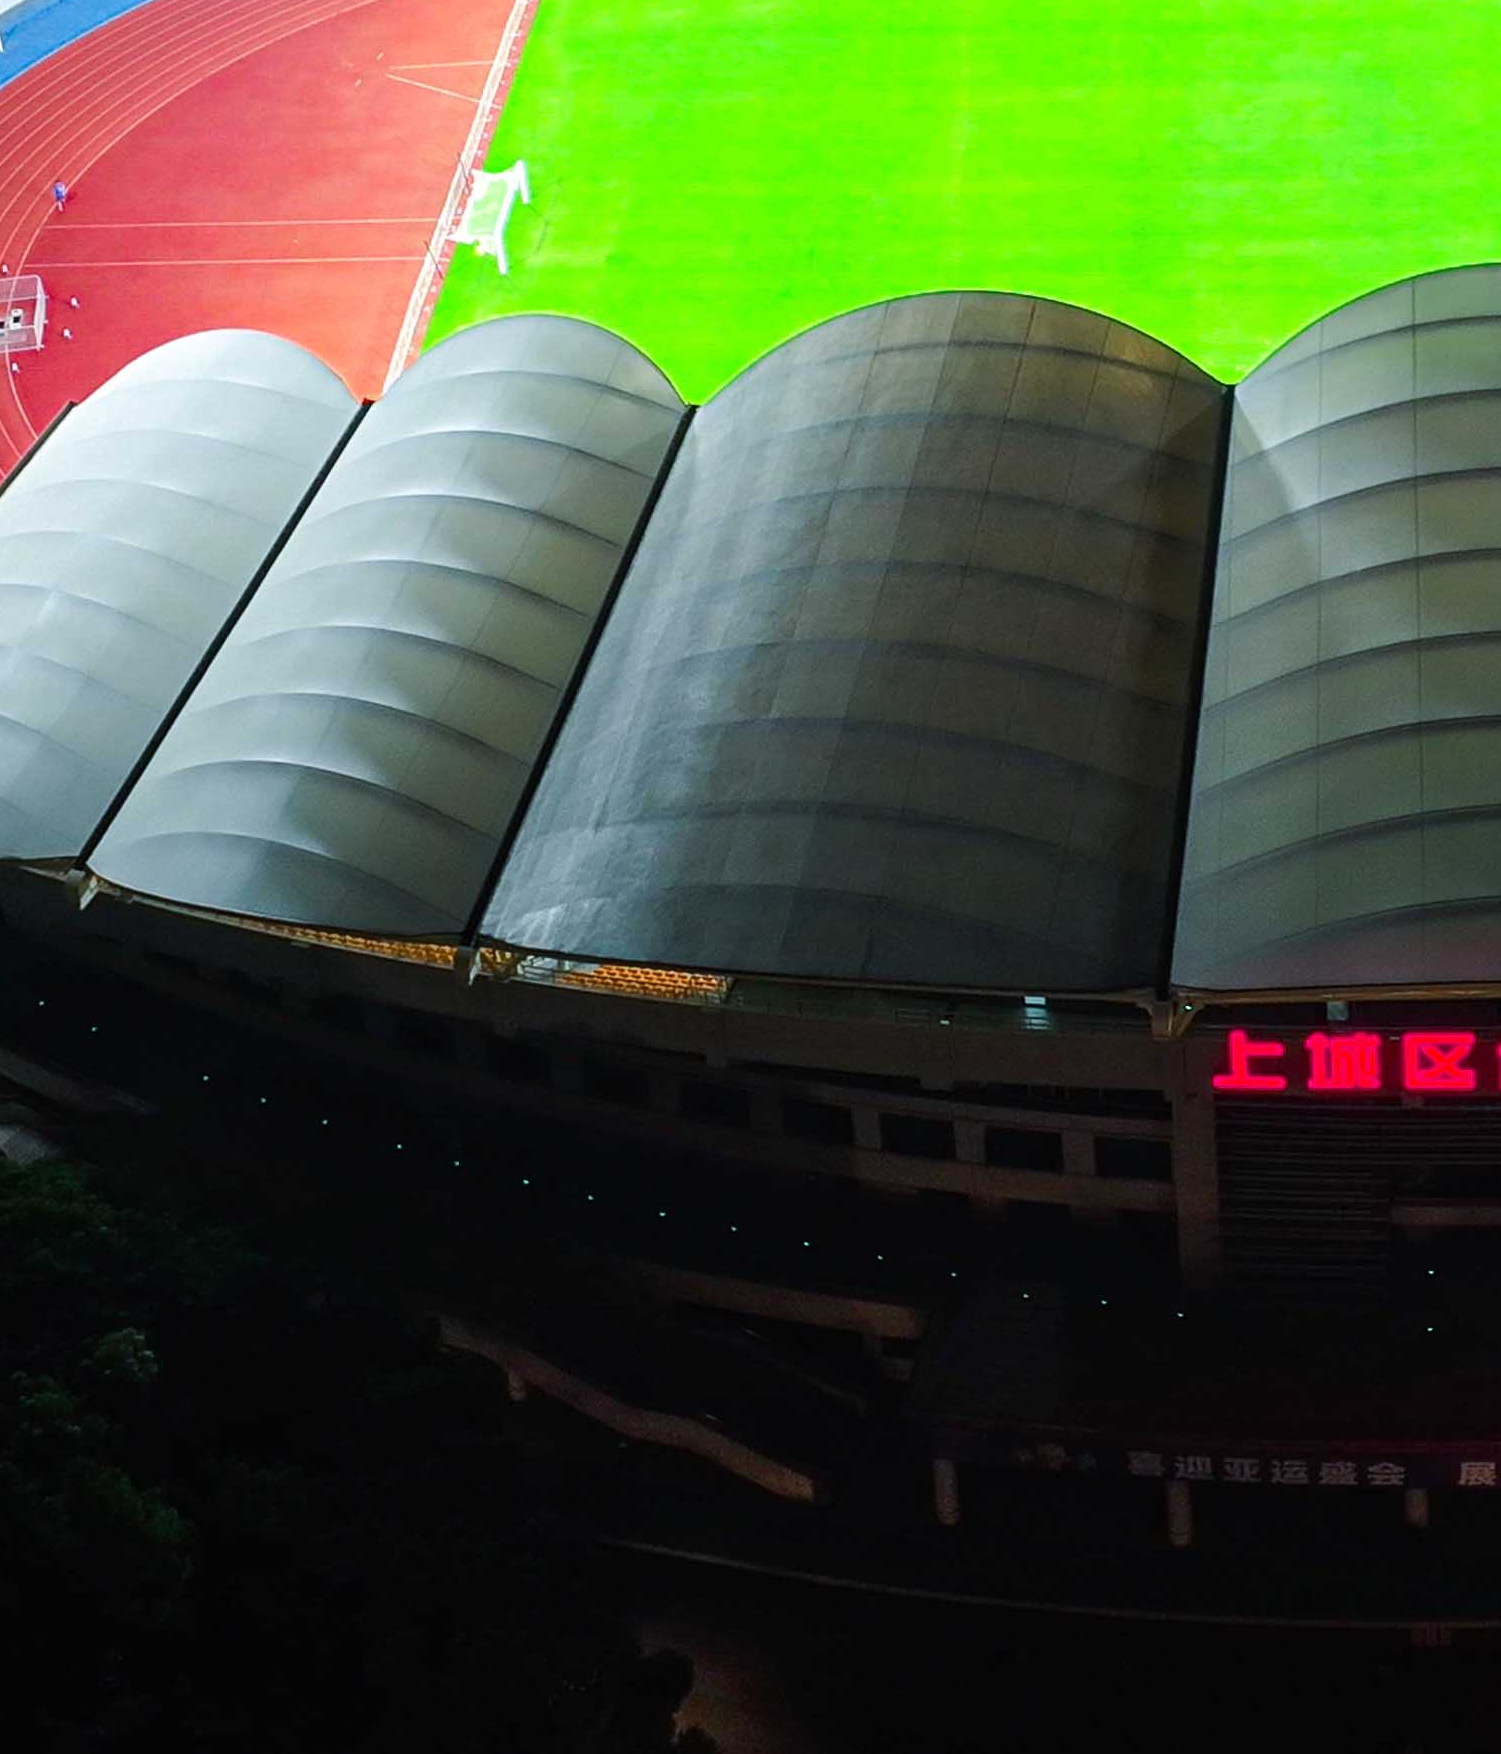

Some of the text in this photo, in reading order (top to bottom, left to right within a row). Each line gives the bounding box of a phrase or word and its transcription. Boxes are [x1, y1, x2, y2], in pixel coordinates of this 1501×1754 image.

[1127, 1450, 1406, 1485] 喜迎亚运盛会
